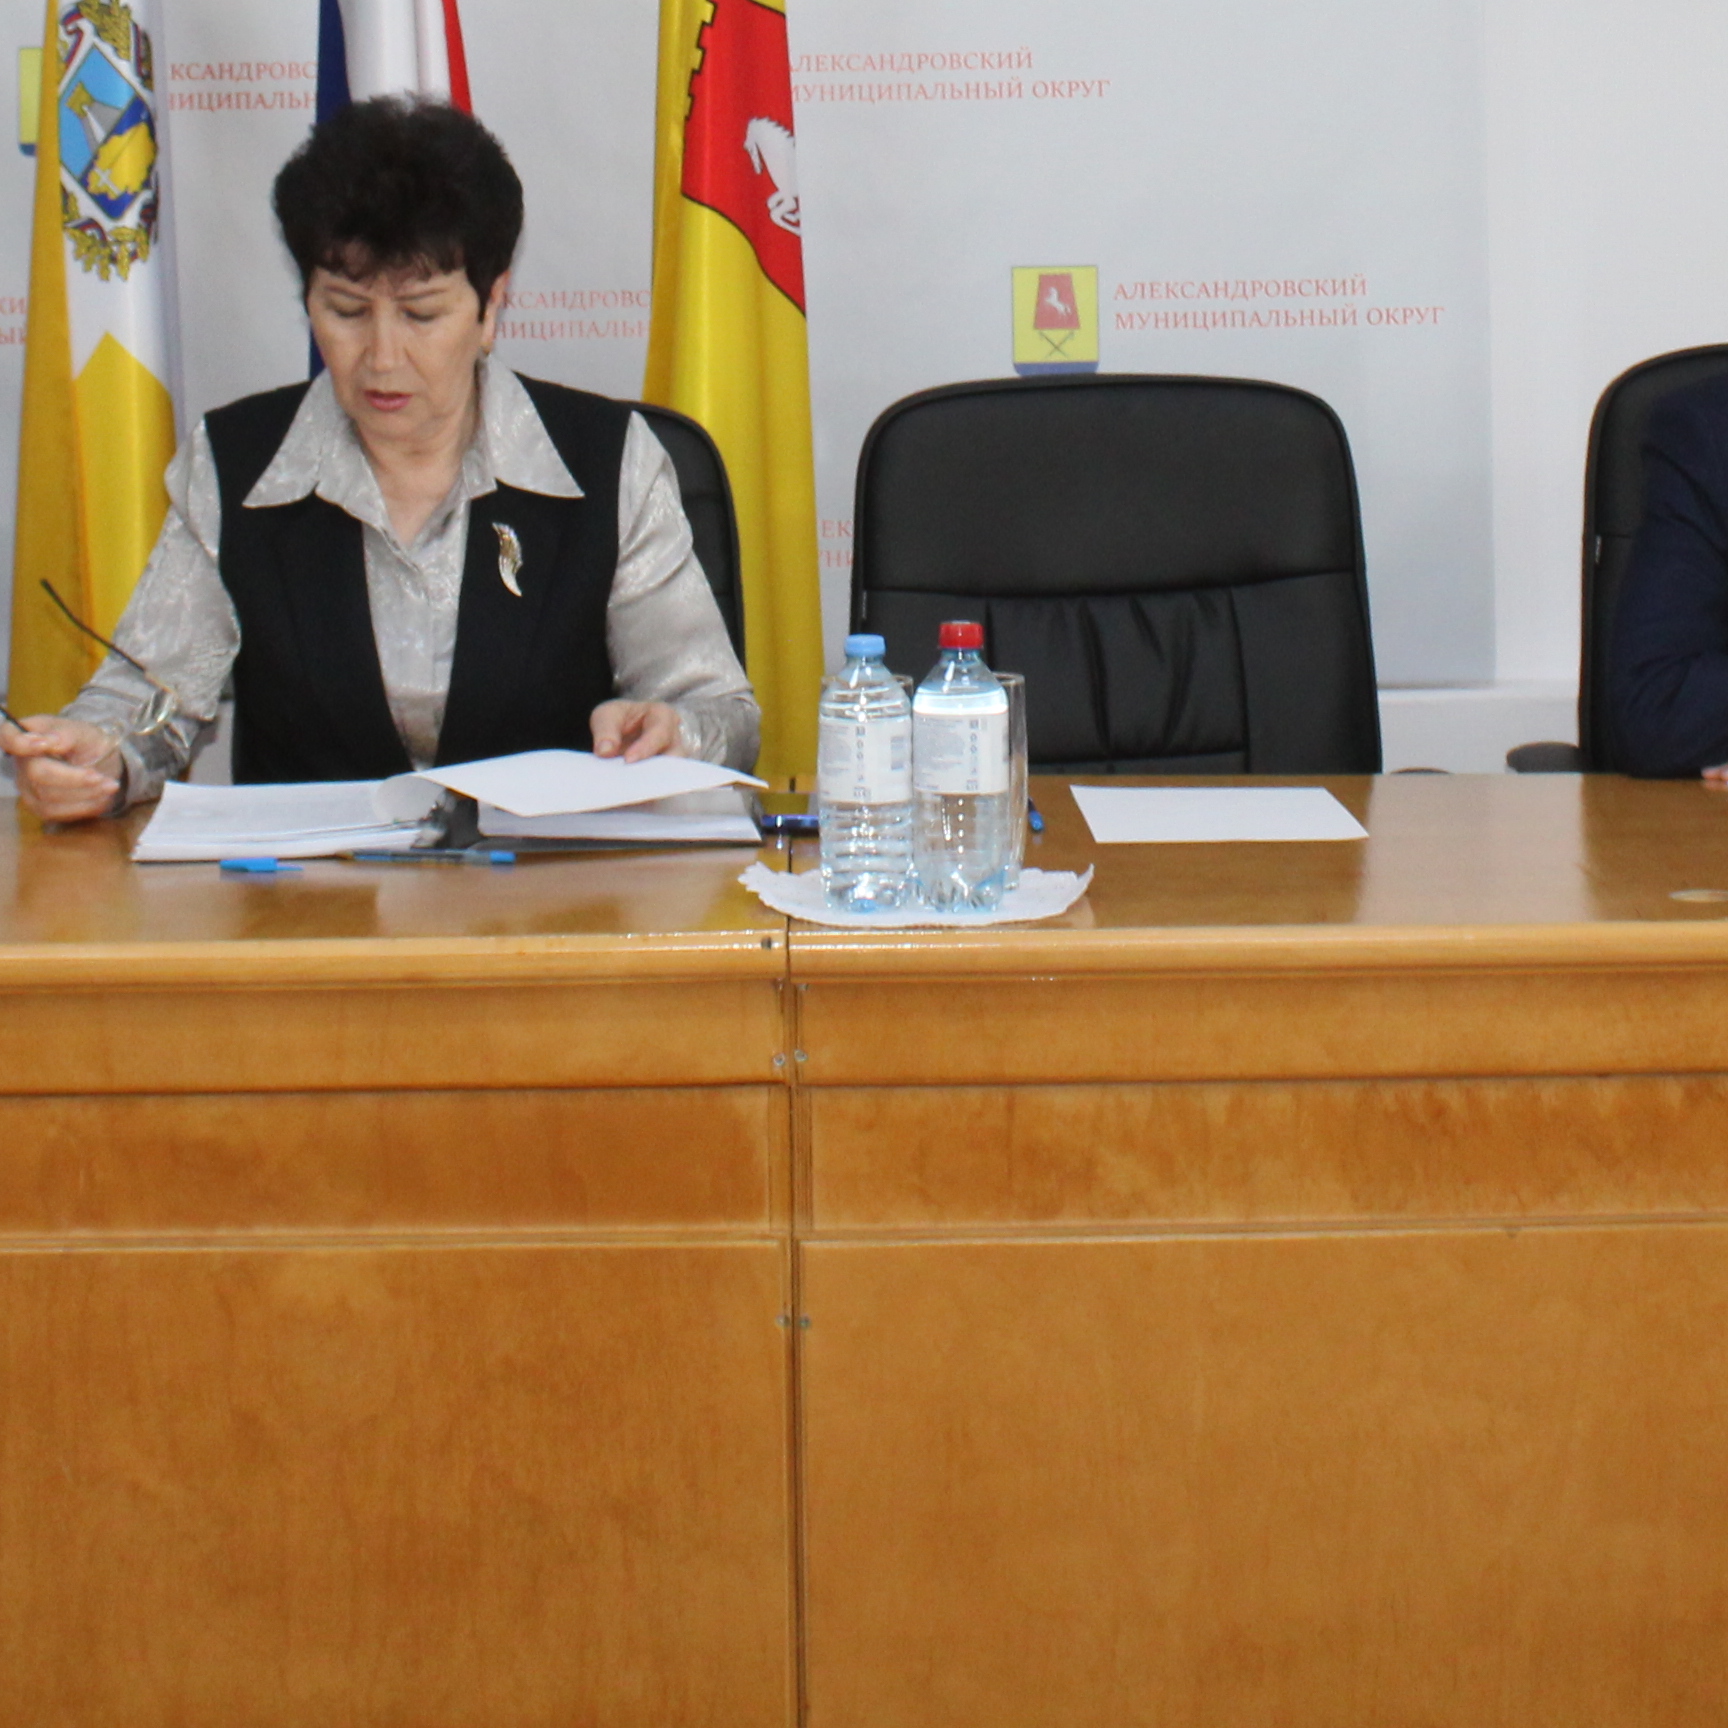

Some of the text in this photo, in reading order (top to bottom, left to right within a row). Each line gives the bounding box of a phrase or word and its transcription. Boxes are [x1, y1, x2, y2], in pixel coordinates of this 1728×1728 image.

[790, 46, 1032, 73] ЛЕКСАНДРОВСКИЙ
[170, 61, 317, 84] КСАНДРОВС
[1032, 79, 1110, 100] ОКРУГ
[1114, 273, 1367, 301] АЛЕКСАНДРОВСКИЙ
[501, 290, 651, 312] КСАНДРОВС
[1115, 303, 1444, 330] МУНИЦИПАЛЬНЫЙ ОКРУГ
